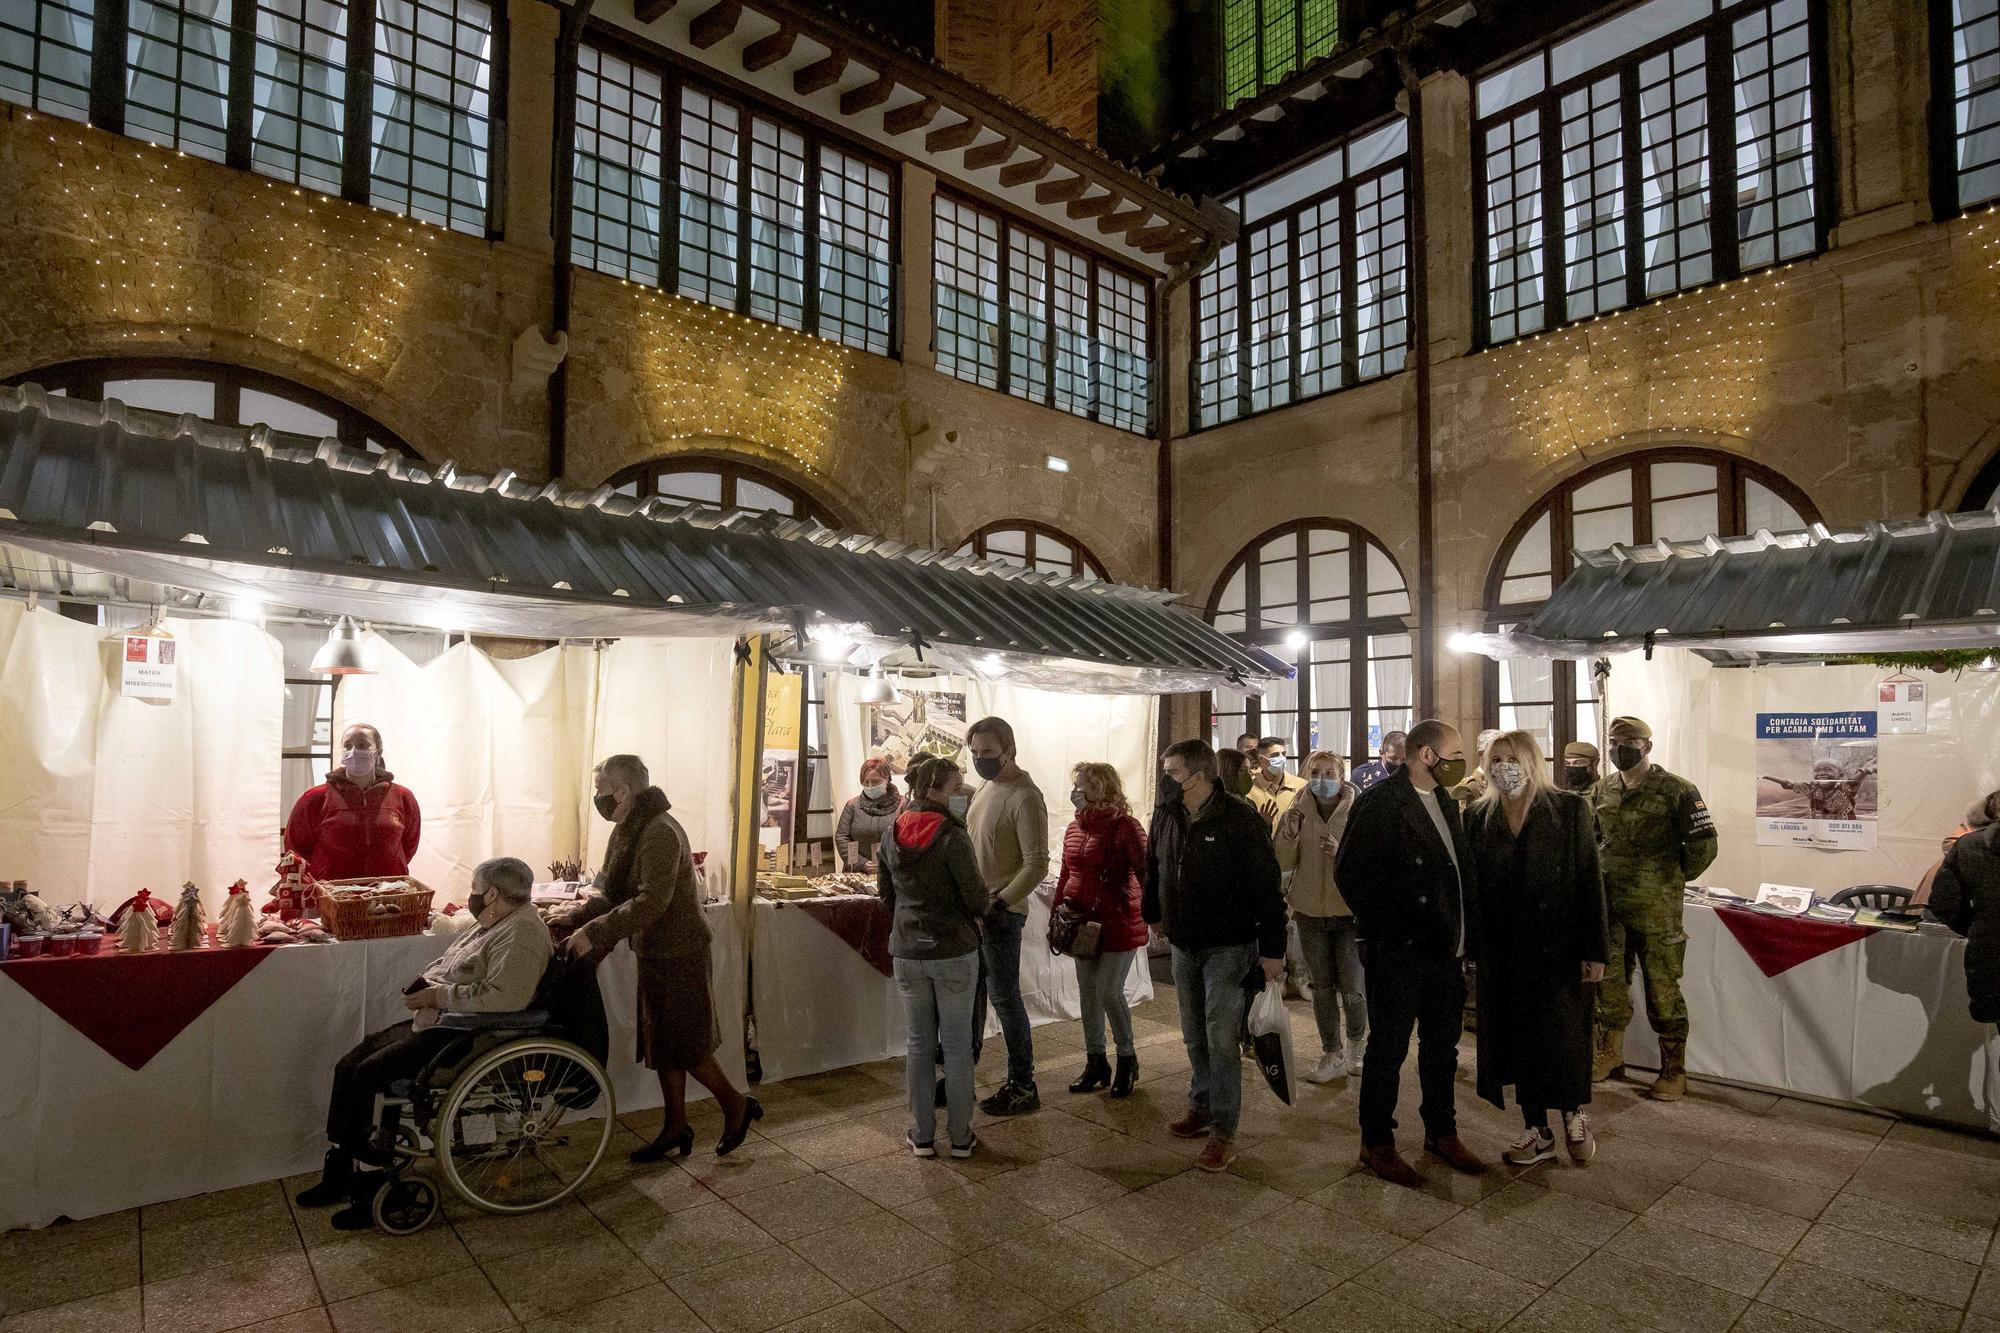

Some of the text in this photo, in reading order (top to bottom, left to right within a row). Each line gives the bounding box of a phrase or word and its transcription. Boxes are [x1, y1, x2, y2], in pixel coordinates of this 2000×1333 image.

[1770, 717, 1862, 726] CONTAGIA SOLIDARITAT
[1766, 726, 1781, 734] PER
[1783, 725, 1813, 734] ACABAR
[1836, 725, 1846, 733] LA
[1849, 725, 1867, 733] FAM
